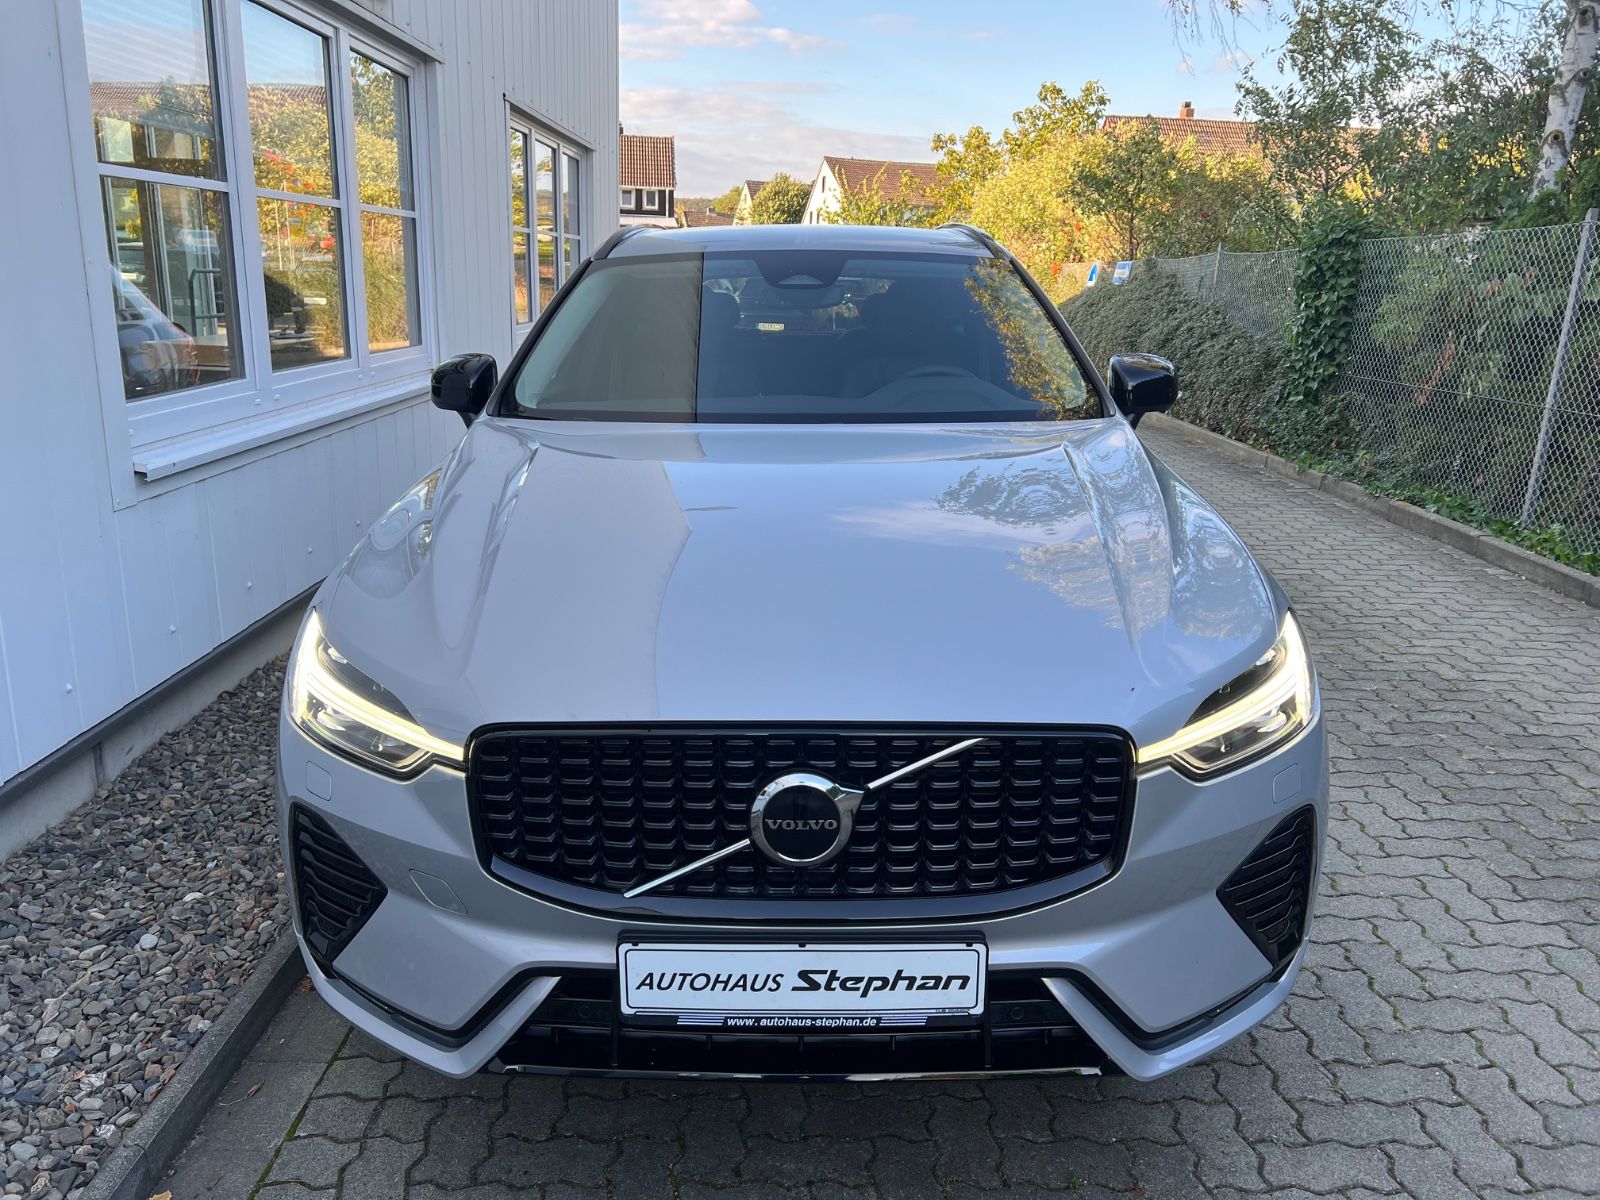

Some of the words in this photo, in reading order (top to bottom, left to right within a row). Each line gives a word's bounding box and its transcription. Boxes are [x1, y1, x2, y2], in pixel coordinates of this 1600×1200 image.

[764, 818, 838, 830] VOLVO
[635, 972, 784, 992] AUTOHAUS
[791, 969, 971, 998] Stephan
